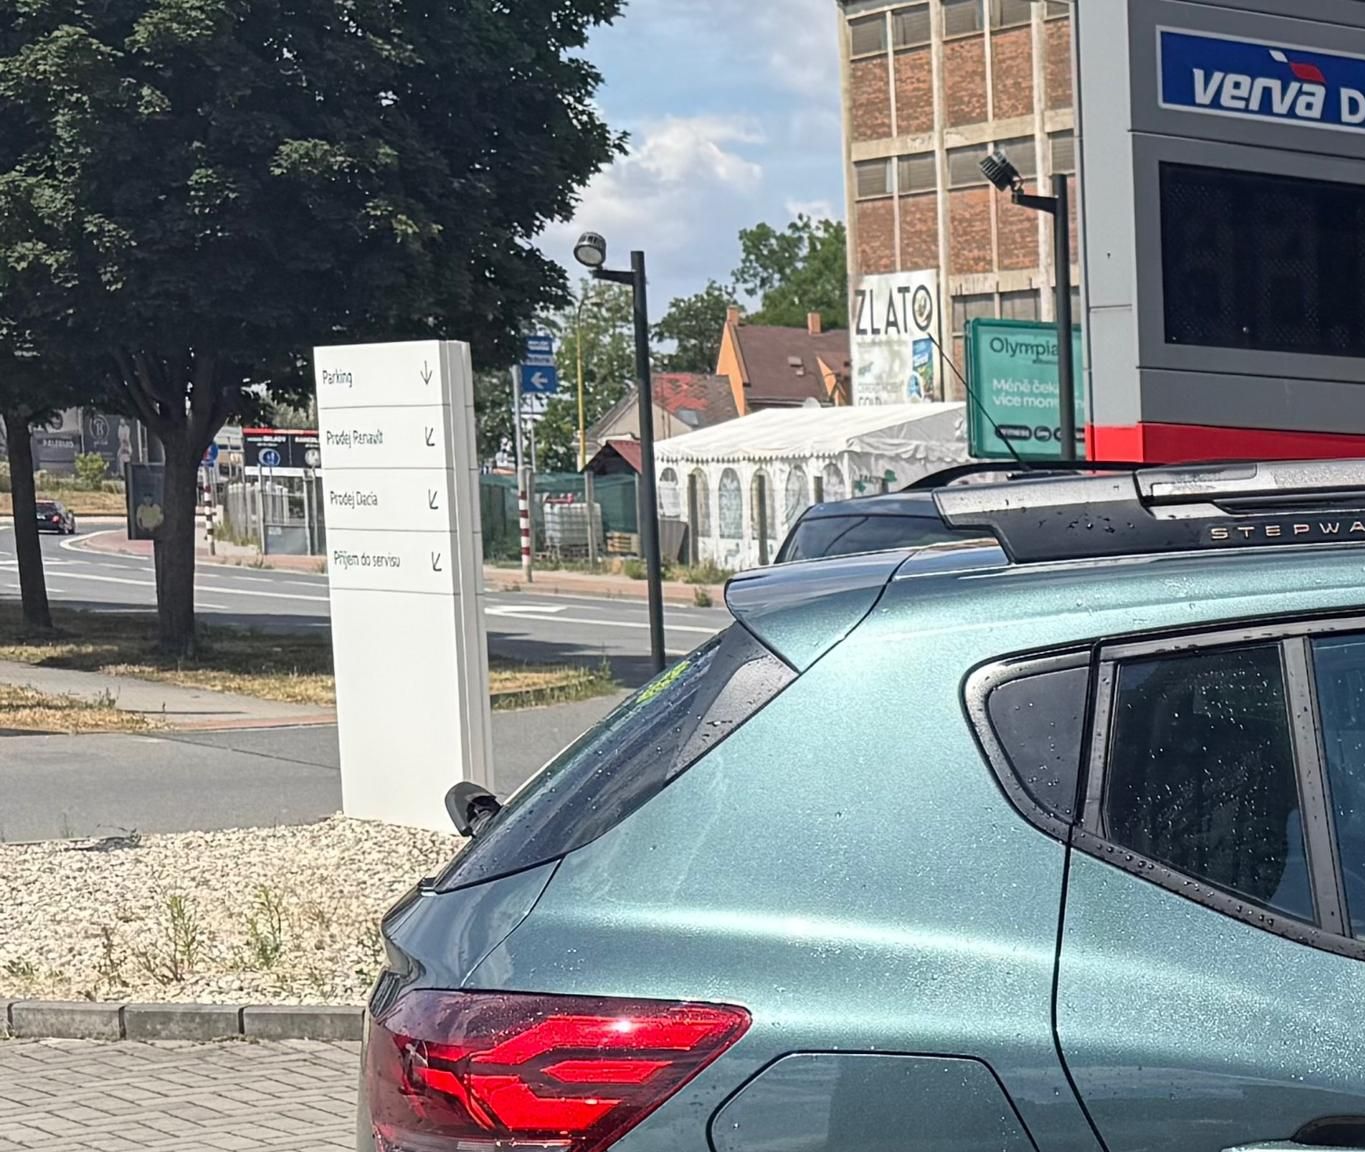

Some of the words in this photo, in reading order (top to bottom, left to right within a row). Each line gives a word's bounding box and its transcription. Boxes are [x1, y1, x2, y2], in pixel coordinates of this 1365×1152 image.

[1193, 67, 1326, 119] verva
[855, 284, 933, 335] ZLATO
[322, 369, 353, 388] Parking
[992, 392, 1022, 407] více
[326, 430, 351, 448] Prodej
[330, 490, 355, 509] Prodej
[356, 490, 378, 506] Dacia
[360, 552, 371, 567] do
[372, 552, 401, 568] servisu
